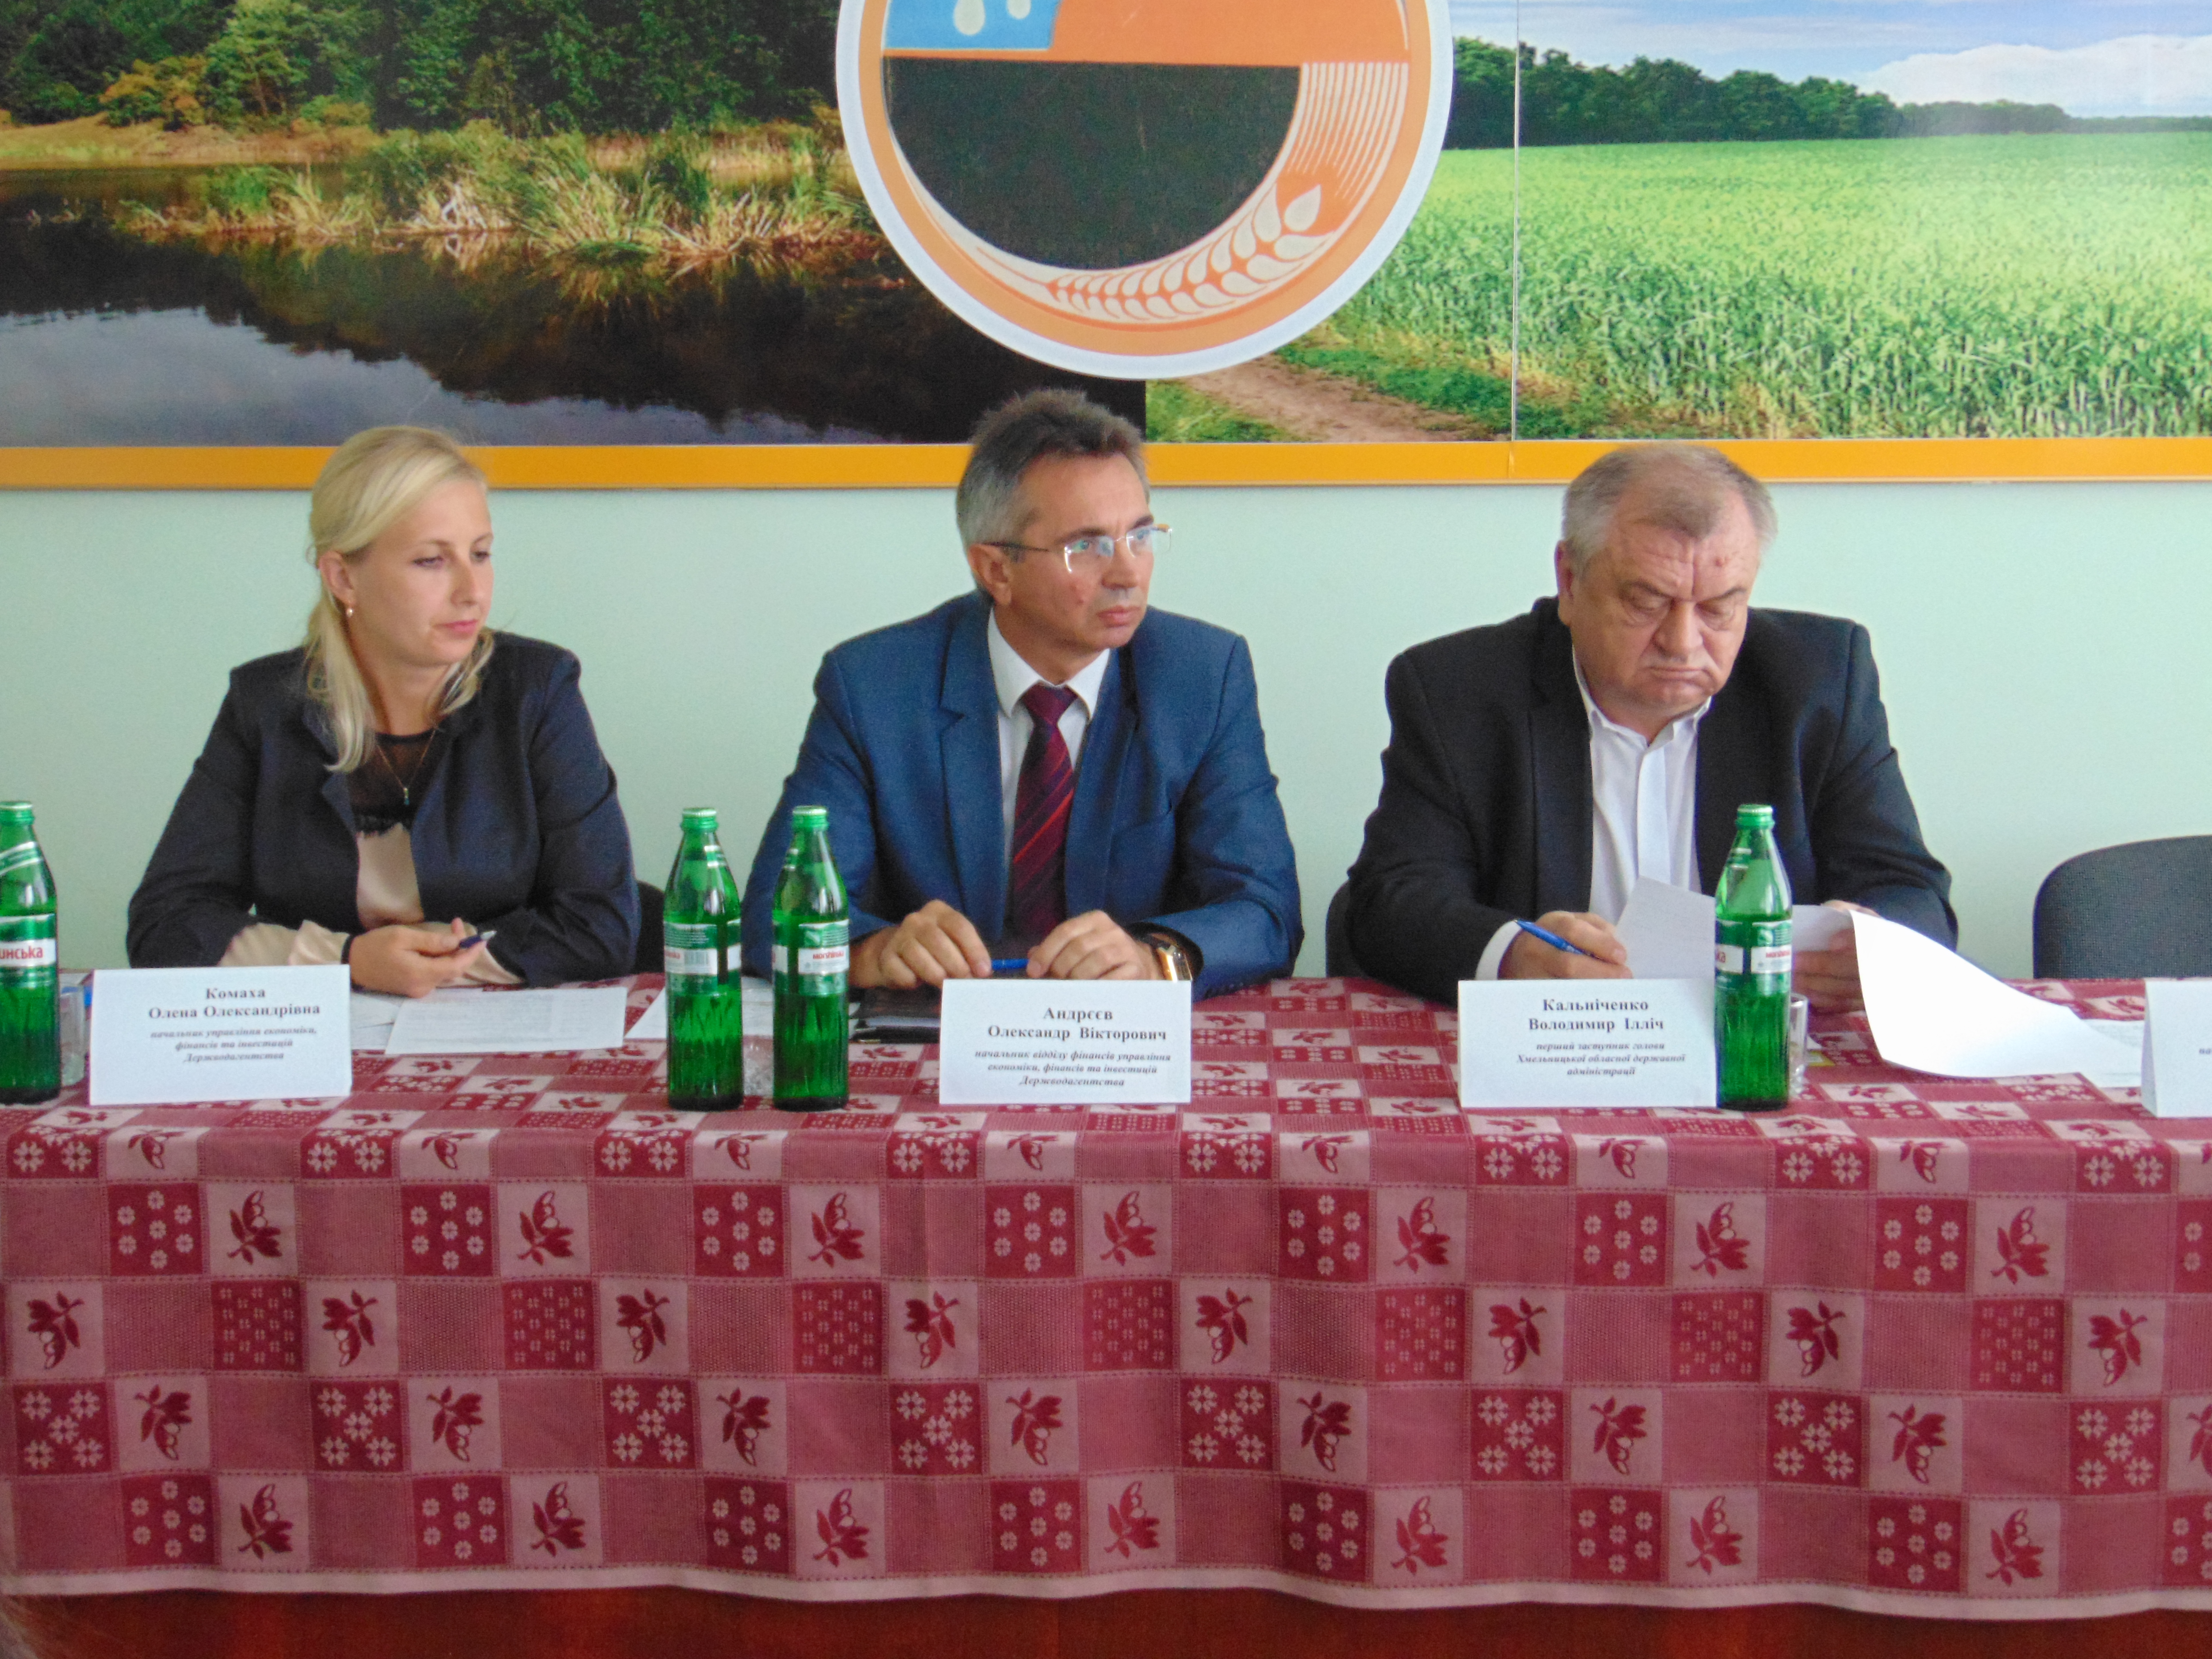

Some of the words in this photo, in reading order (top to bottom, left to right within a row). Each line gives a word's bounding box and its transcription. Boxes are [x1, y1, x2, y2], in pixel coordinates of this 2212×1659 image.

[205, 988, 266, 1000] Комаха
[148, 1007, 198, 1019] Олена
[203, 1003, 321, 1019] Олександрівна
[1543, 998, 1649, 1012] Кальніченко
[1528, 1018, 1616, 1034] Володимир
[1624, 1017, 1664, 1030] Ілліч
[987, 1025, 1071, 1042] Олександр
[1079, 1026, 1167, 1044] Вікторович
